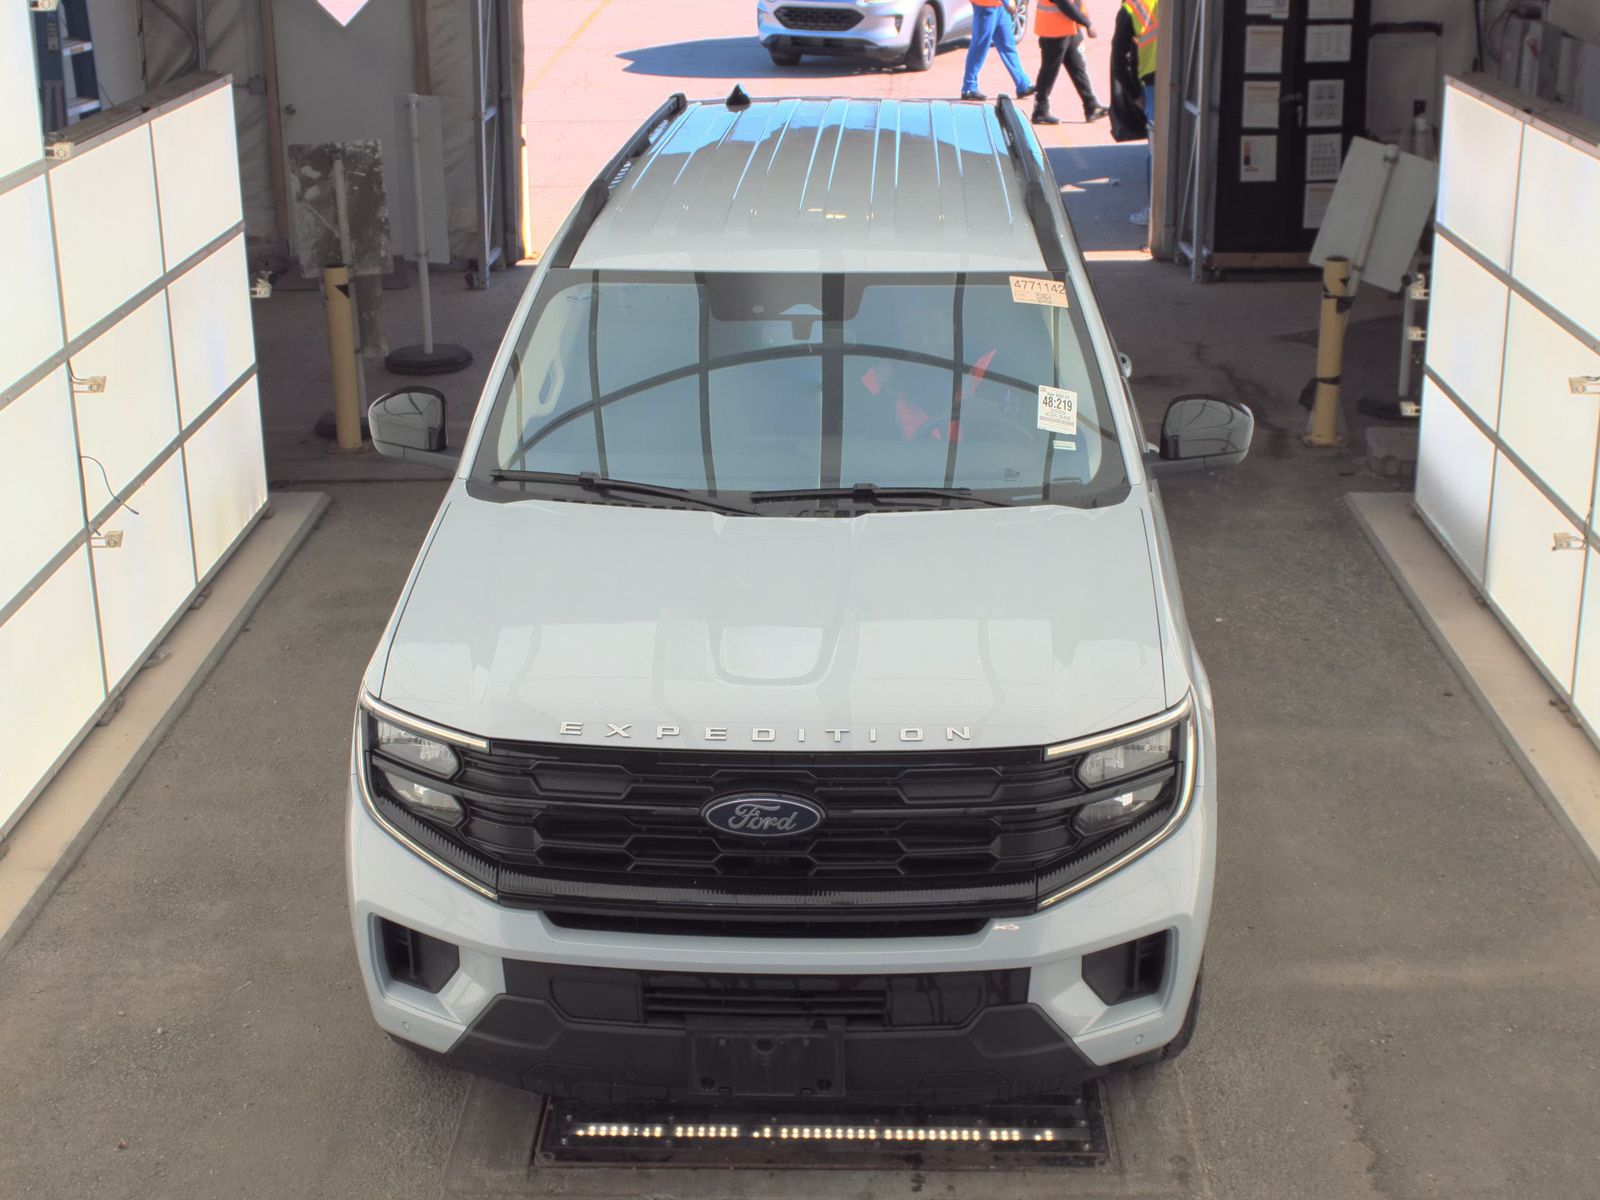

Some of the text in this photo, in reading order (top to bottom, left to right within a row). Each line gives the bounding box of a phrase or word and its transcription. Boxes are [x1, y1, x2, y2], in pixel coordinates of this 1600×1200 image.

[1014, 279, 1065, 295] 4771142
[1042, 395, 1073, 412] 48:219
[559, 720, 972, 743] EXPEDITION
[728, 802, 798, 831] Ford
